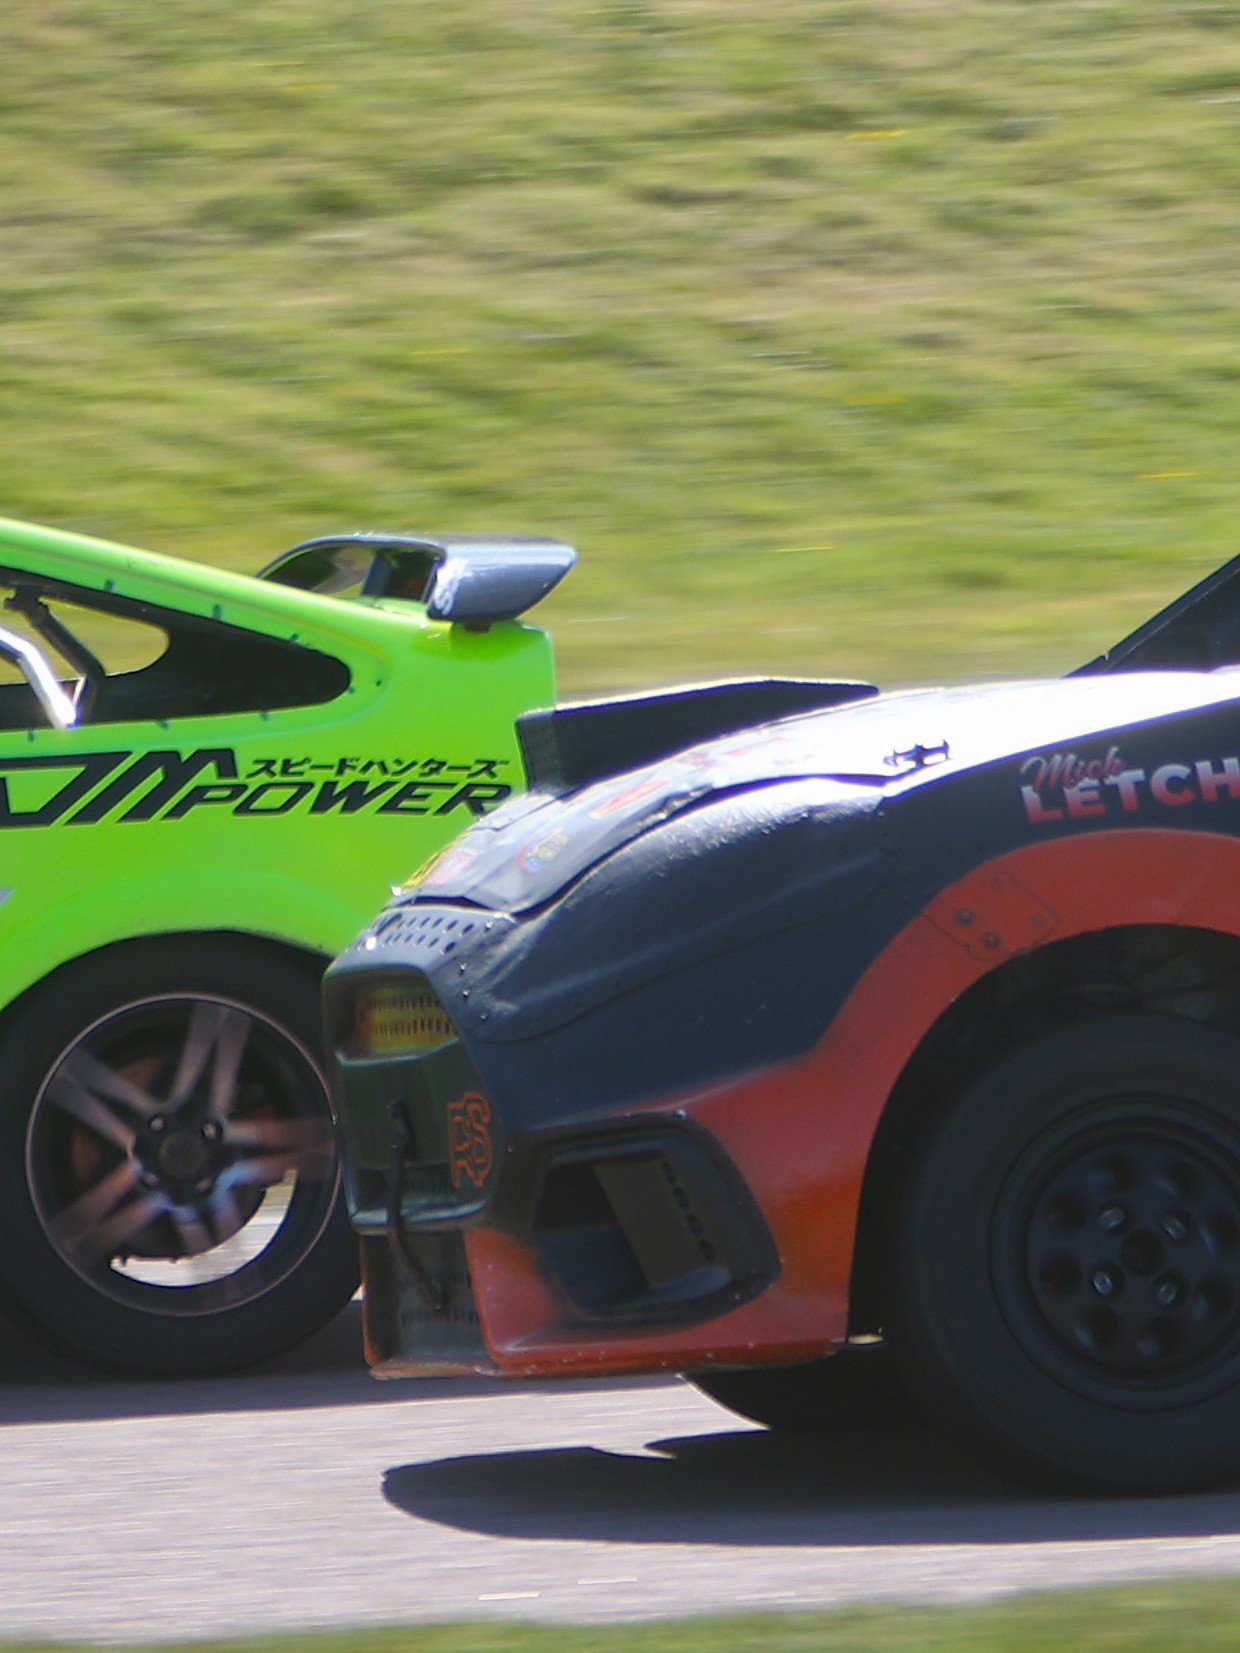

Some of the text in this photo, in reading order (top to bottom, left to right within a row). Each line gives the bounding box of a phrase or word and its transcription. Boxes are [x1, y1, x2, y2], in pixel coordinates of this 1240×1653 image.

[246, 756, 510, 779] スピードハンターズ
[1020, 745, 1125, 792] Mick
[160, 779, 512, 821] POWER
